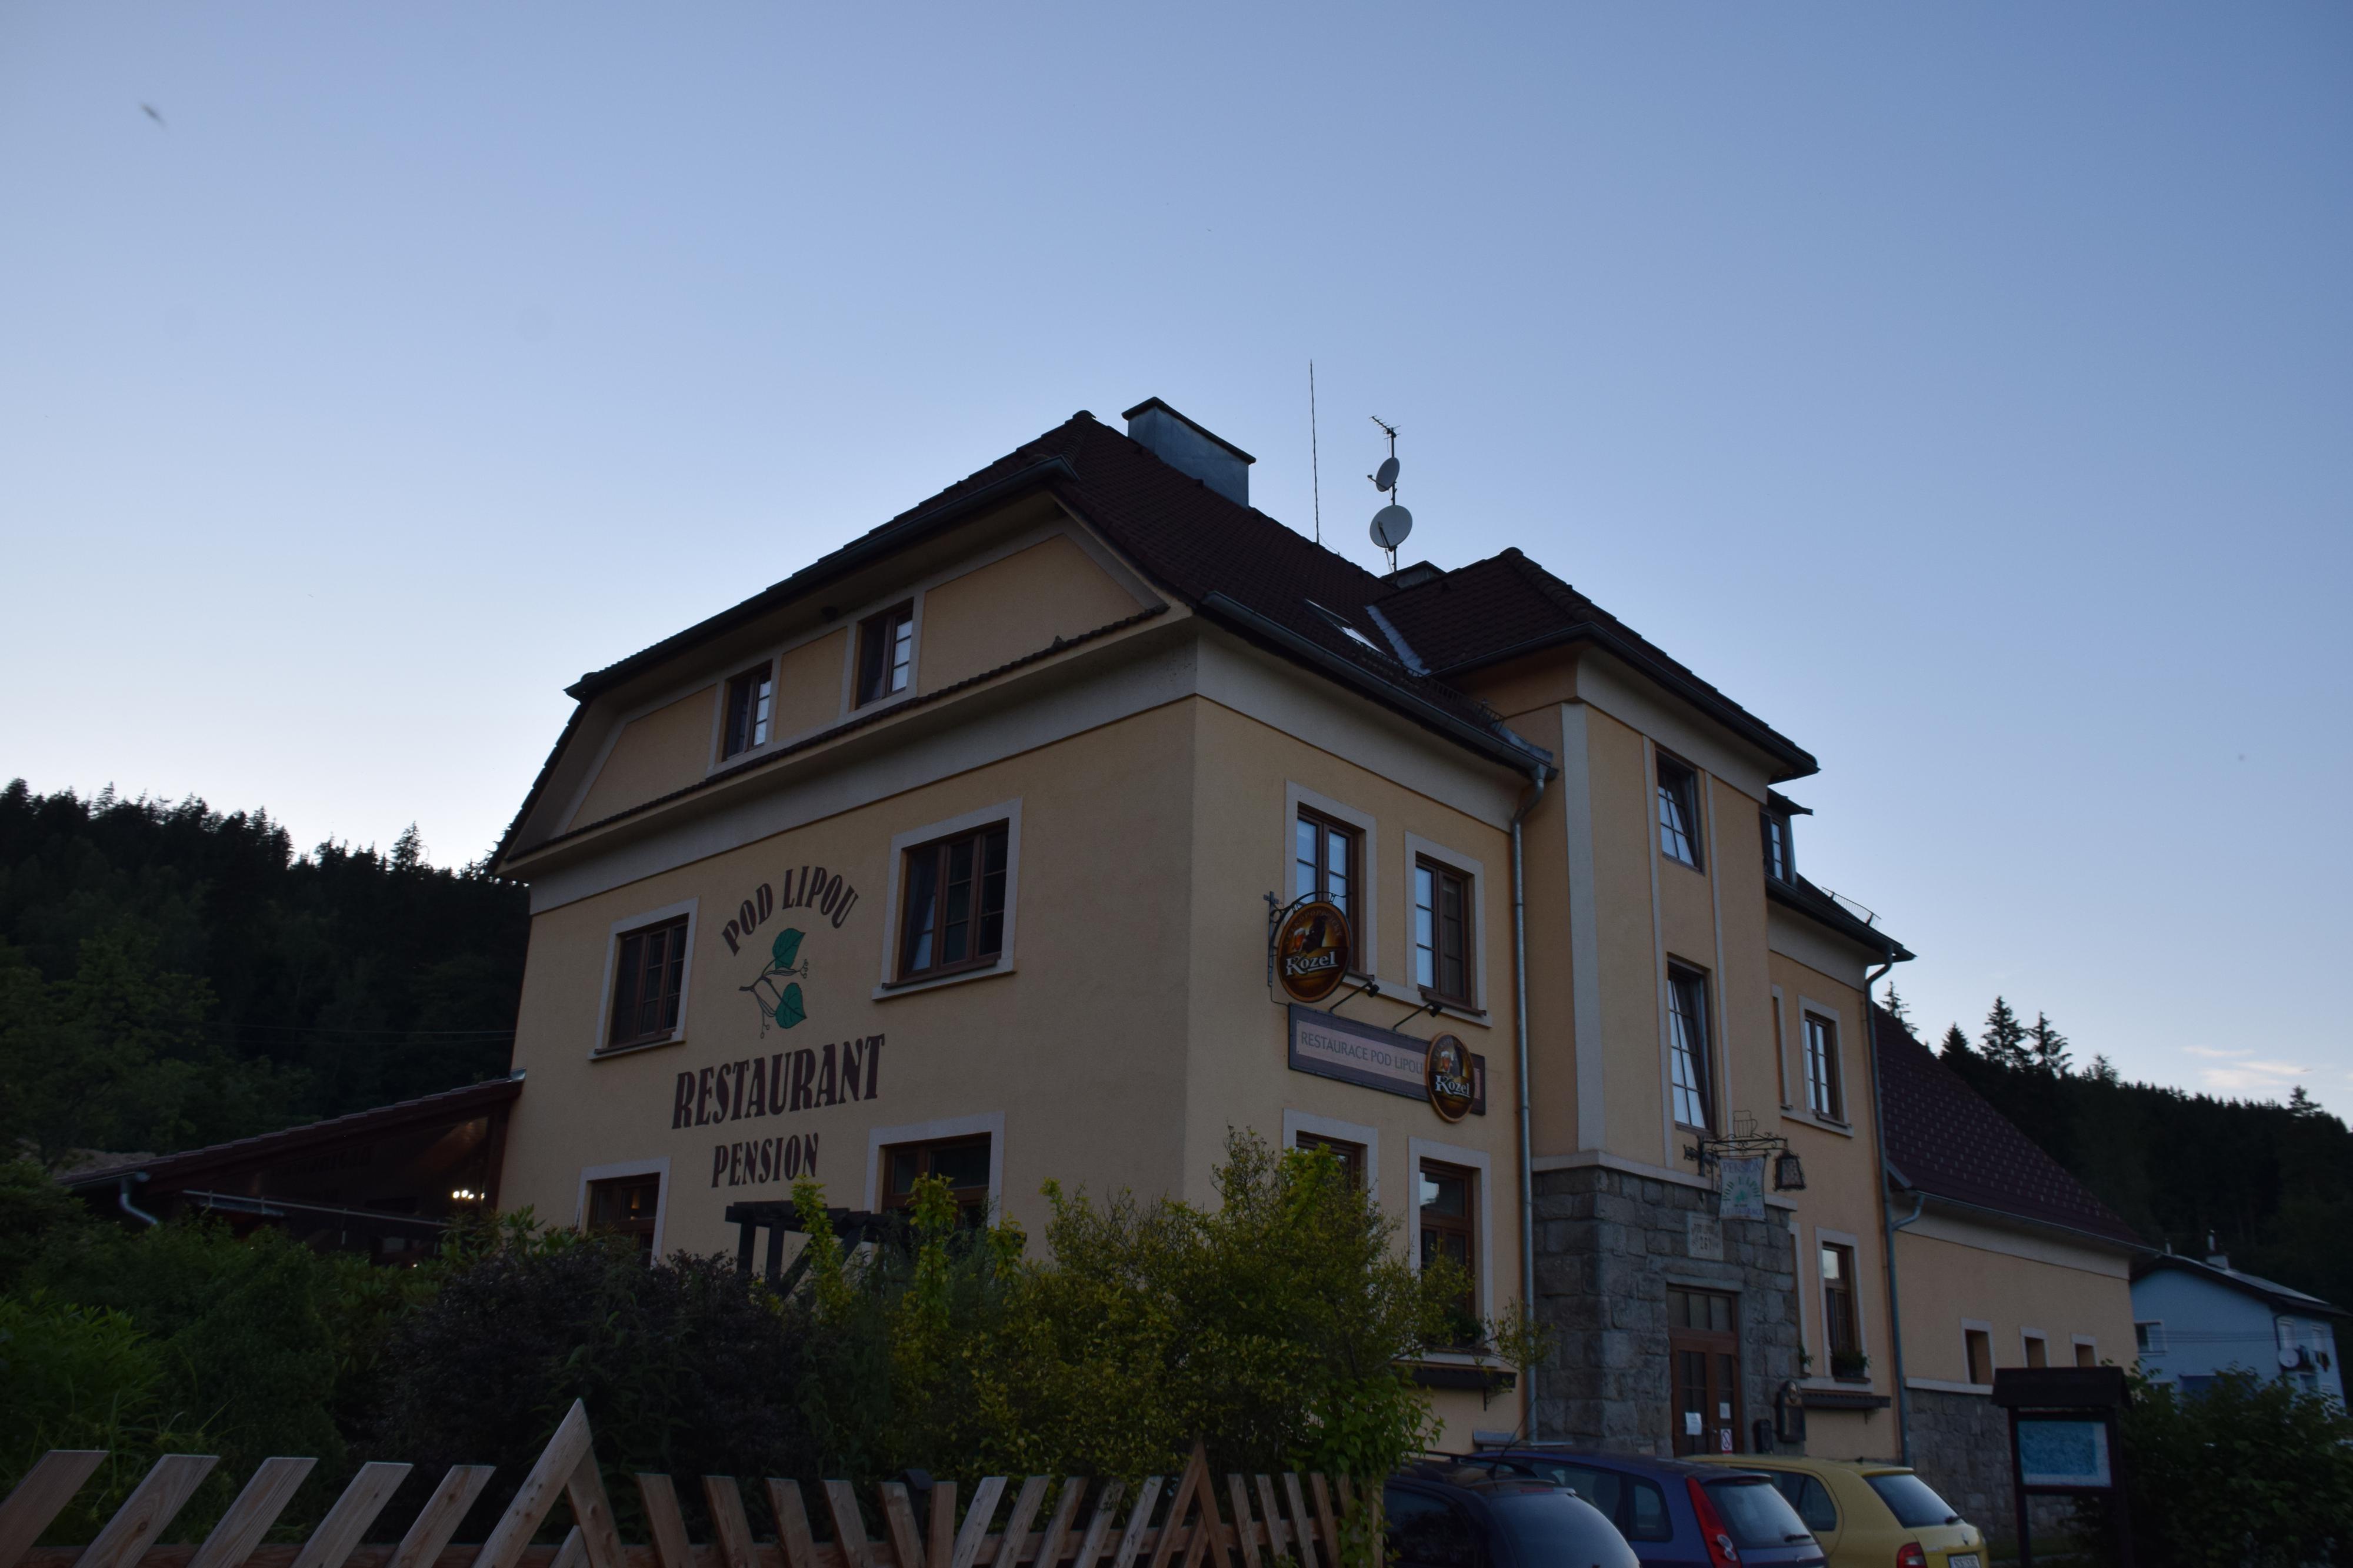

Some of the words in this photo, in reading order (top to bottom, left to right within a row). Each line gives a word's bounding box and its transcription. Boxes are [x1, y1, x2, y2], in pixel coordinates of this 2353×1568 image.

[721, 882, 773, 956] POD
[782, 865, 859, 929] LIPOU
[1285, 950, 1339, 976] Kozel
[1301, 1031, 1368, 1060] RESTAURACE
[1371, 1049, 1392, 1066] POD
[1394, 1056, 1423, 1075] LIPOU
[672, 1033, 885, 1129] RESTAURANT
[1435, 1075, 1471, 1097] Kozel
[711, 1132, 819, 1188] PENSION
